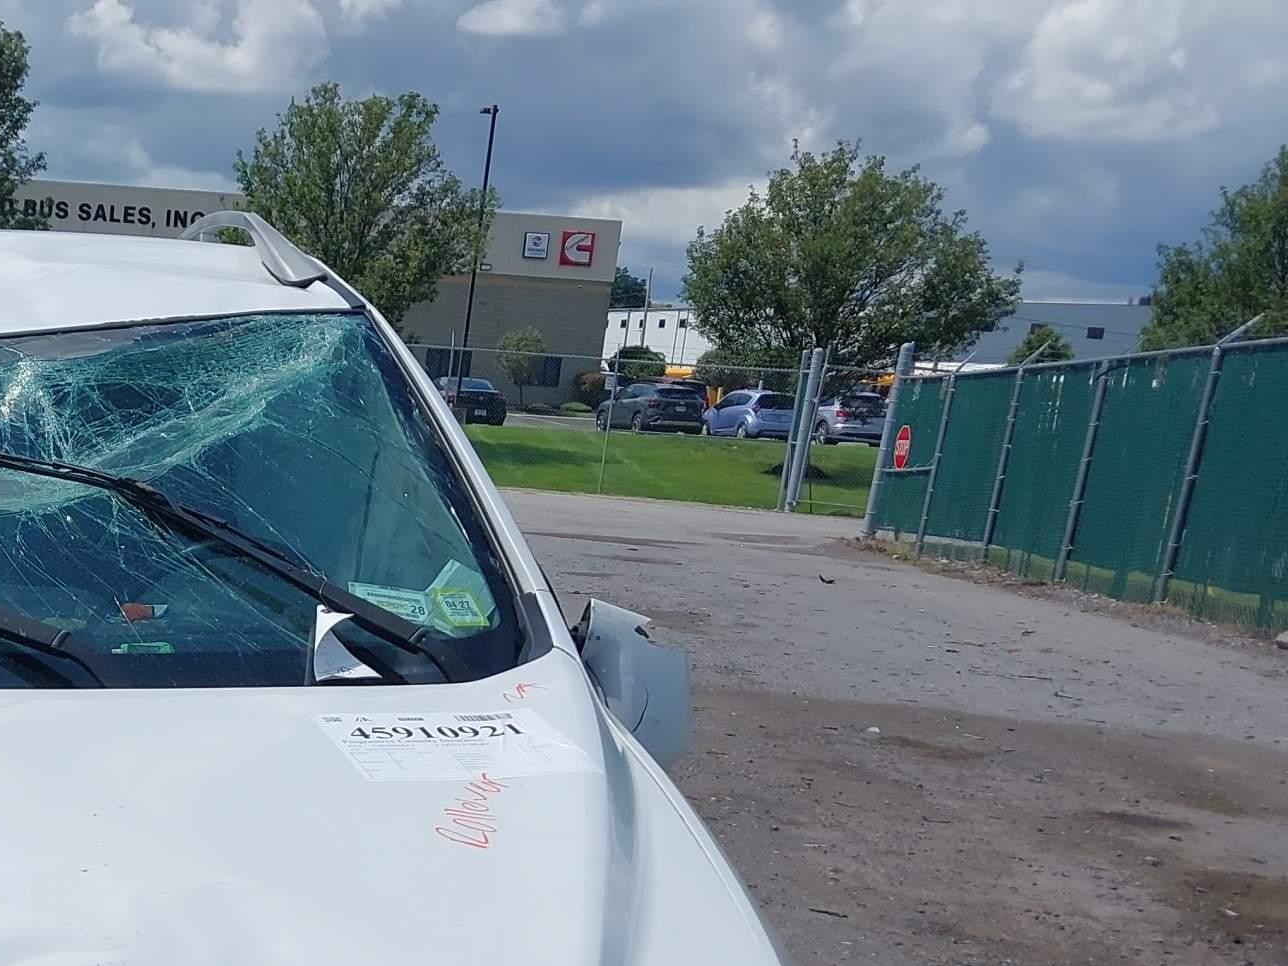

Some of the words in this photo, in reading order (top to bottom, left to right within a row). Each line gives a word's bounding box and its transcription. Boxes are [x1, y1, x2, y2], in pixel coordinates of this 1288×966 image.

[23, 199, 69, 219] BUS
[77, 203, 156, 229] SALES,
[896, 440, 909, 456] STOP
[410, 605, 426, 616] 28
[350, 723, 527, 740] 45910921
